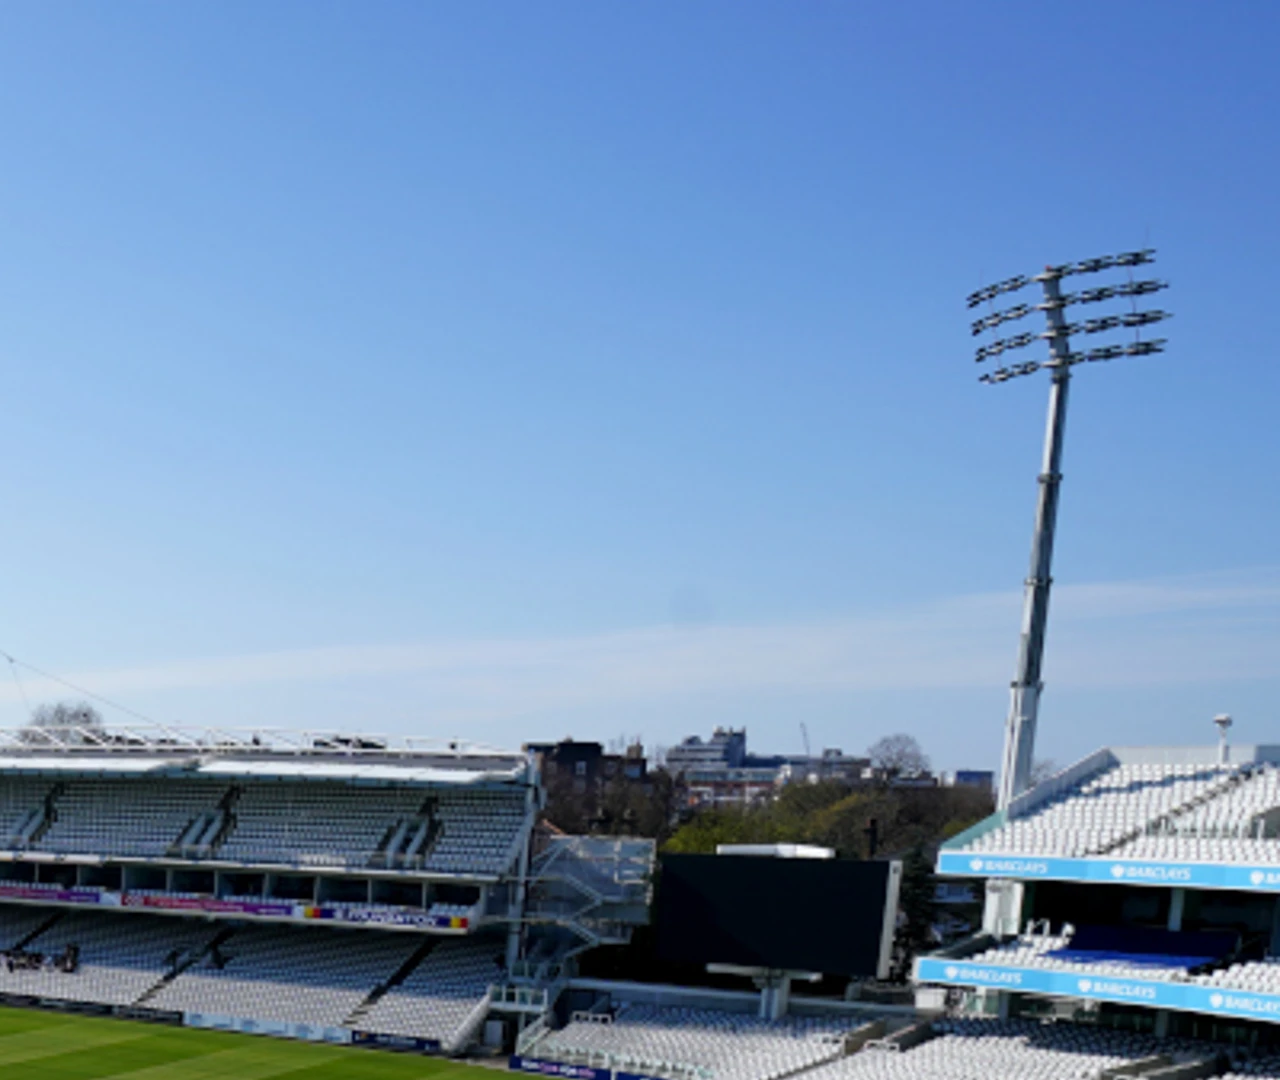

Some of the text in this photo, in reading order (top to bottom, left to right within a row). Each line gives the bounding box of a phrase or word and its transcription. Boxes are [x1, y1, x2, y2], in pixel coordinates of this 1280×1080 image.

[985, 861, 1048, 874] BARCLAYS
[1126, 867, 1191, 880] BARCLAYS
[959, 969, 1021, 984] BARCLAYS
[1094, 982, 1156, 998] BARCLAYS
